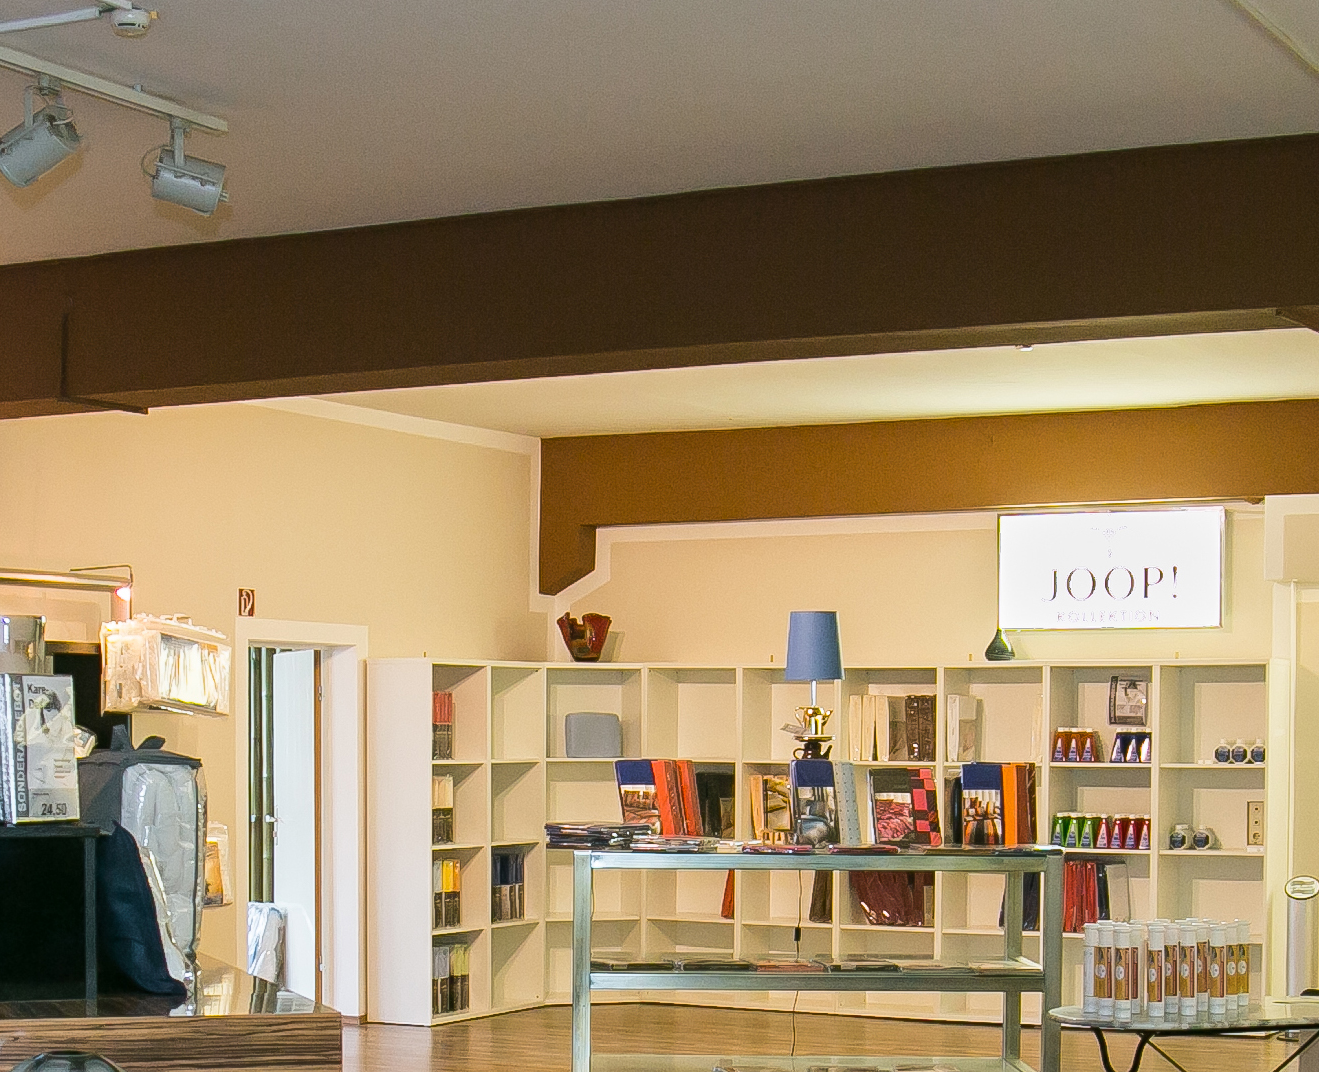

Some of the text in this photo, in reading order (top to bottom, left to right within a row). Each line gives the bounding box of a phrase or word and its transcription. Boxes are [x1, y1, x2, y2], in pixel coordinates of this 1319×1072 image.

[1041, 565, 1178, 602] JOOP!
[1057, 609, 1160, 624] KOLLEKTION
[41, 803, 67, 816] 24.50
